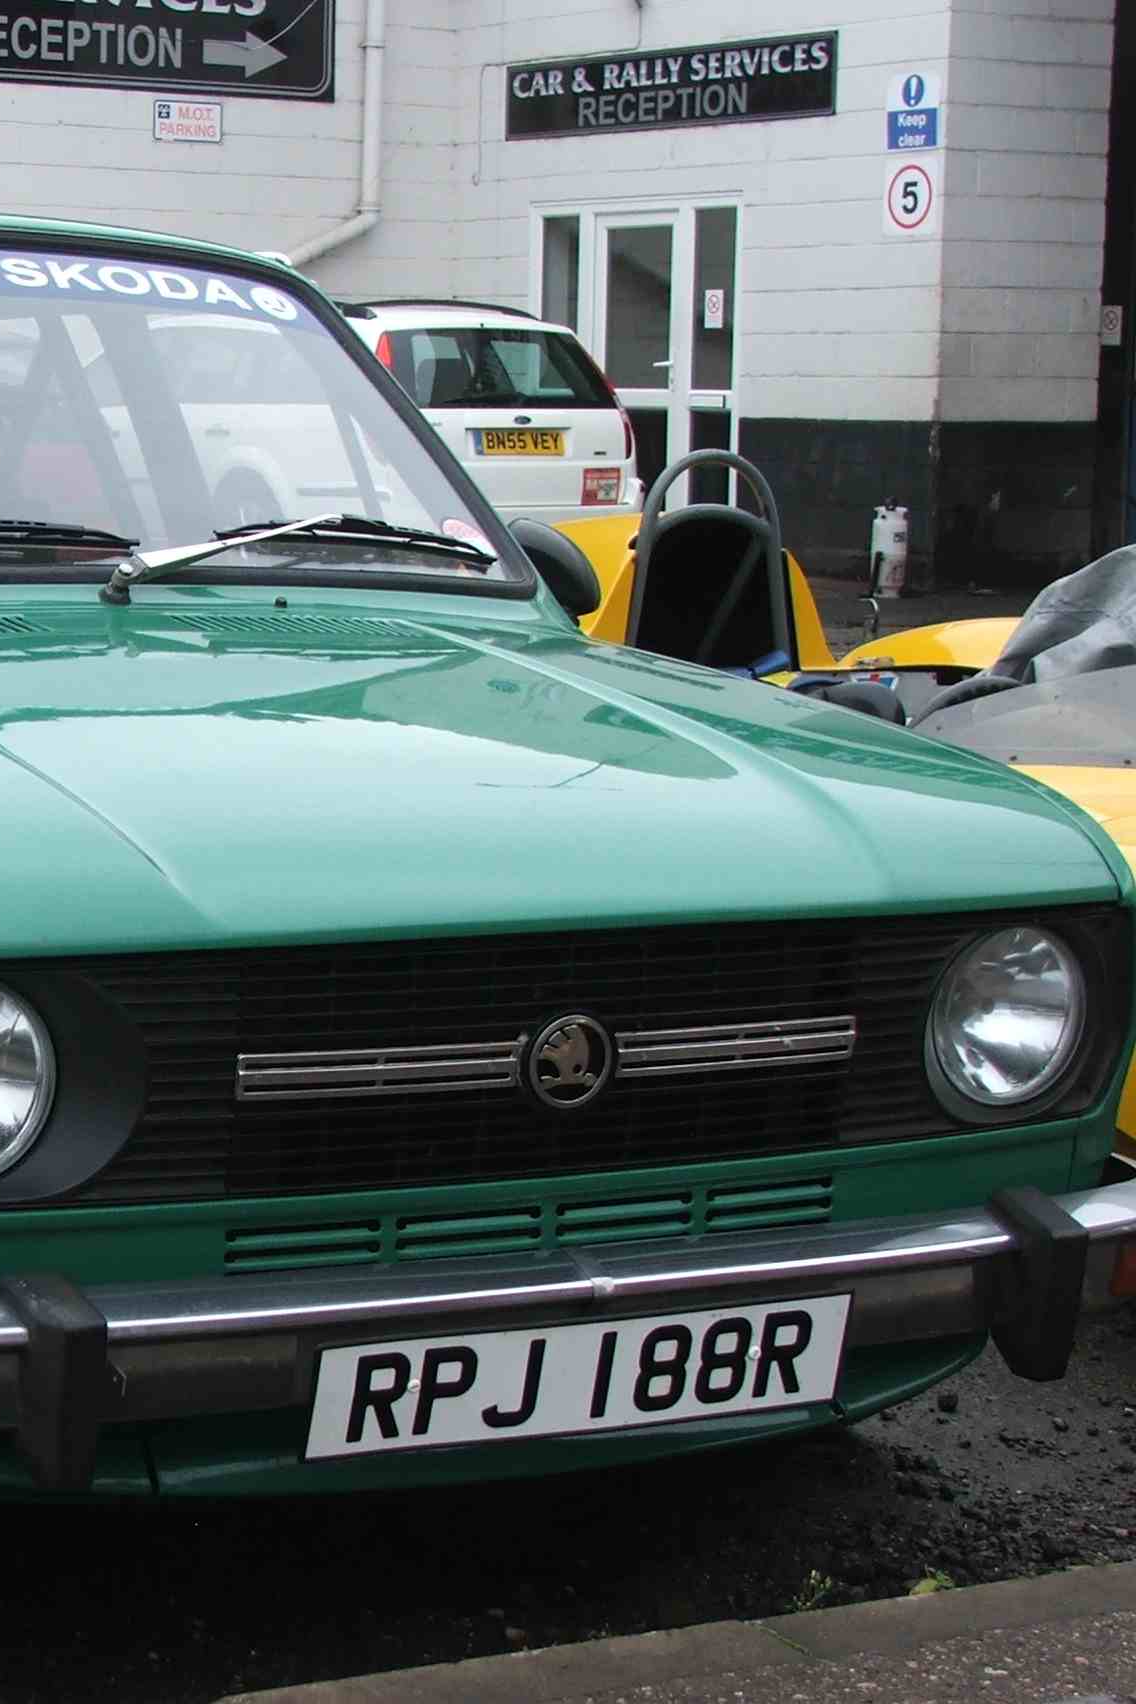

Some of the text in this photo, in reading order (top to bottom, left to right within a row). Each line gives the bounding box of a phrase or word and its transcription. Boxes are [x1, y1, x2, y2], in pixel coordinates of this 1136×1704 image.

[513, 41, 829, 98] CAR & RALLY SERVICES
[577, 82, 748, 127] RECEPTION
[897, 113, 926, 128] Keep
[159, 122, 217, 138] PARKING
[897, 133, 927, 147] clear
[901, 181, 919, 214] 5
[0, 258, 253, 310] SKODA
[485, 430, 561, 450] BN55 VEY
[345, 1310, 812, 1443] RPJ 188R
